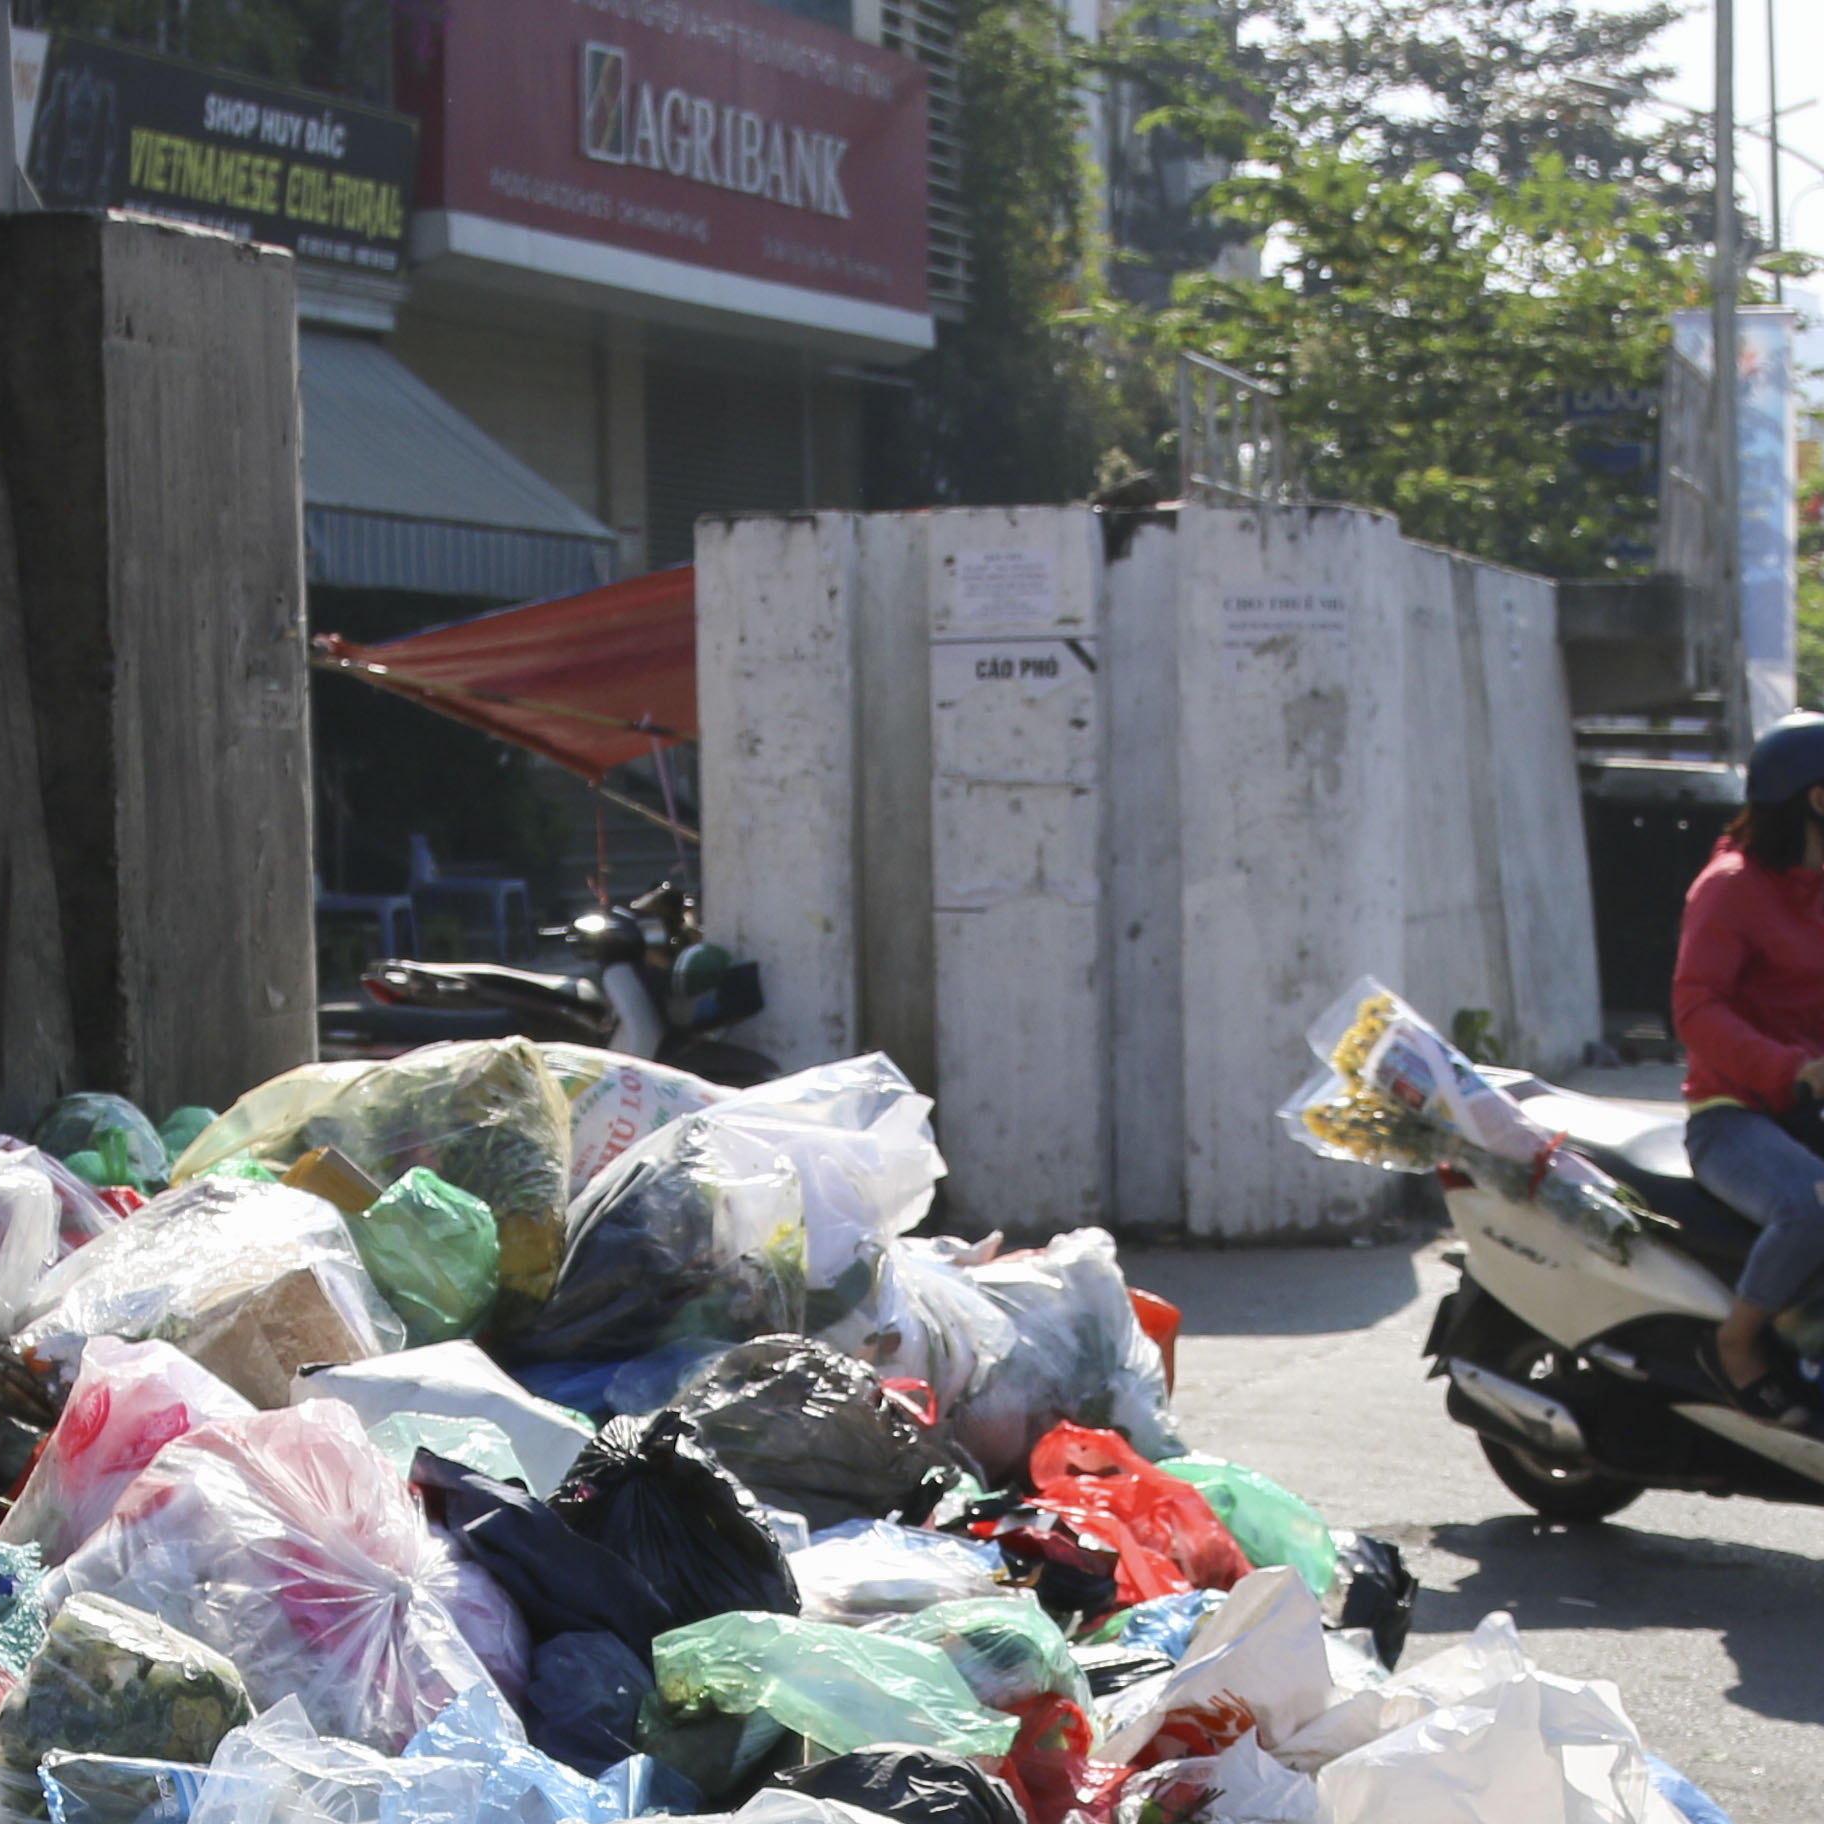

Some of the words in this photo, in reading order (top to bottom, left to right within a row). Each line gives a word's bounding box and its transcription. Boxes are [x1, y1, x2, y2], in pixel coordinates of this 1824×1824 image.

[203, 92, 259, 138] SHOP
[261, 105, 305, 149] HUY
[632, 82, 852, 219] AGRIBANK
[129, 127, 282, 214] VIETNAMESE
[975, 655, 1014, 680] CÁO
